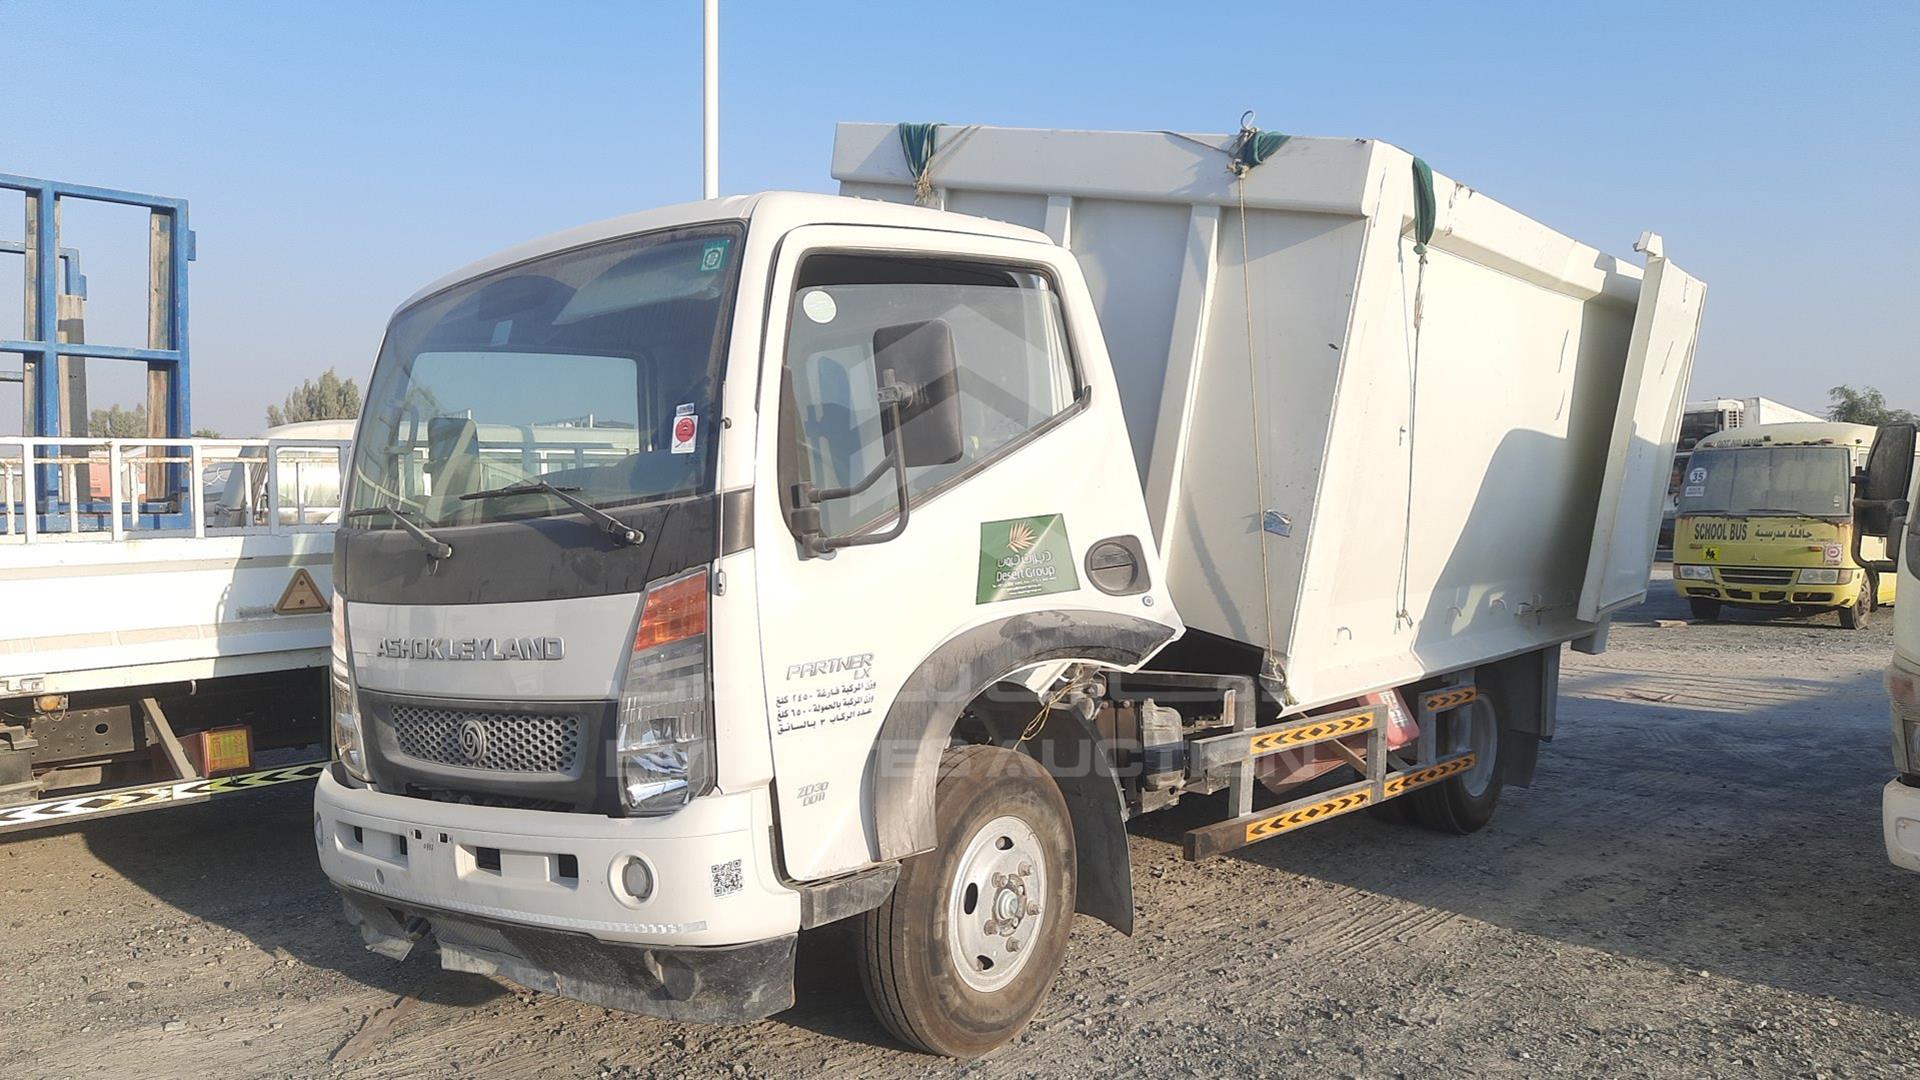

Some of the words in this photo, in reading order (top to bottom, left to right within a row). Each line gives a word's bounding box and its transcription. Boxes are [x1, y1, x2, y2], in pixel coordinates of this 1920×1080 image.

[1692, 472, 1704, 482] 35
[1694, 523, 1727, 540] SCHOOL
[1729, 523, 1747, 540] BUS
[1755, 524, 1786, 541] مدرسية
[1788, 524, 1812, 538] حافلة
[996, 569, 1025, 582] Desert
[1025, 566, 1056, 578] Group
[376, 637, 444, 660] ASHOK
[448, 636, 567, 661] LEYLAND
[786, 653, 875, 681] PARTNER
